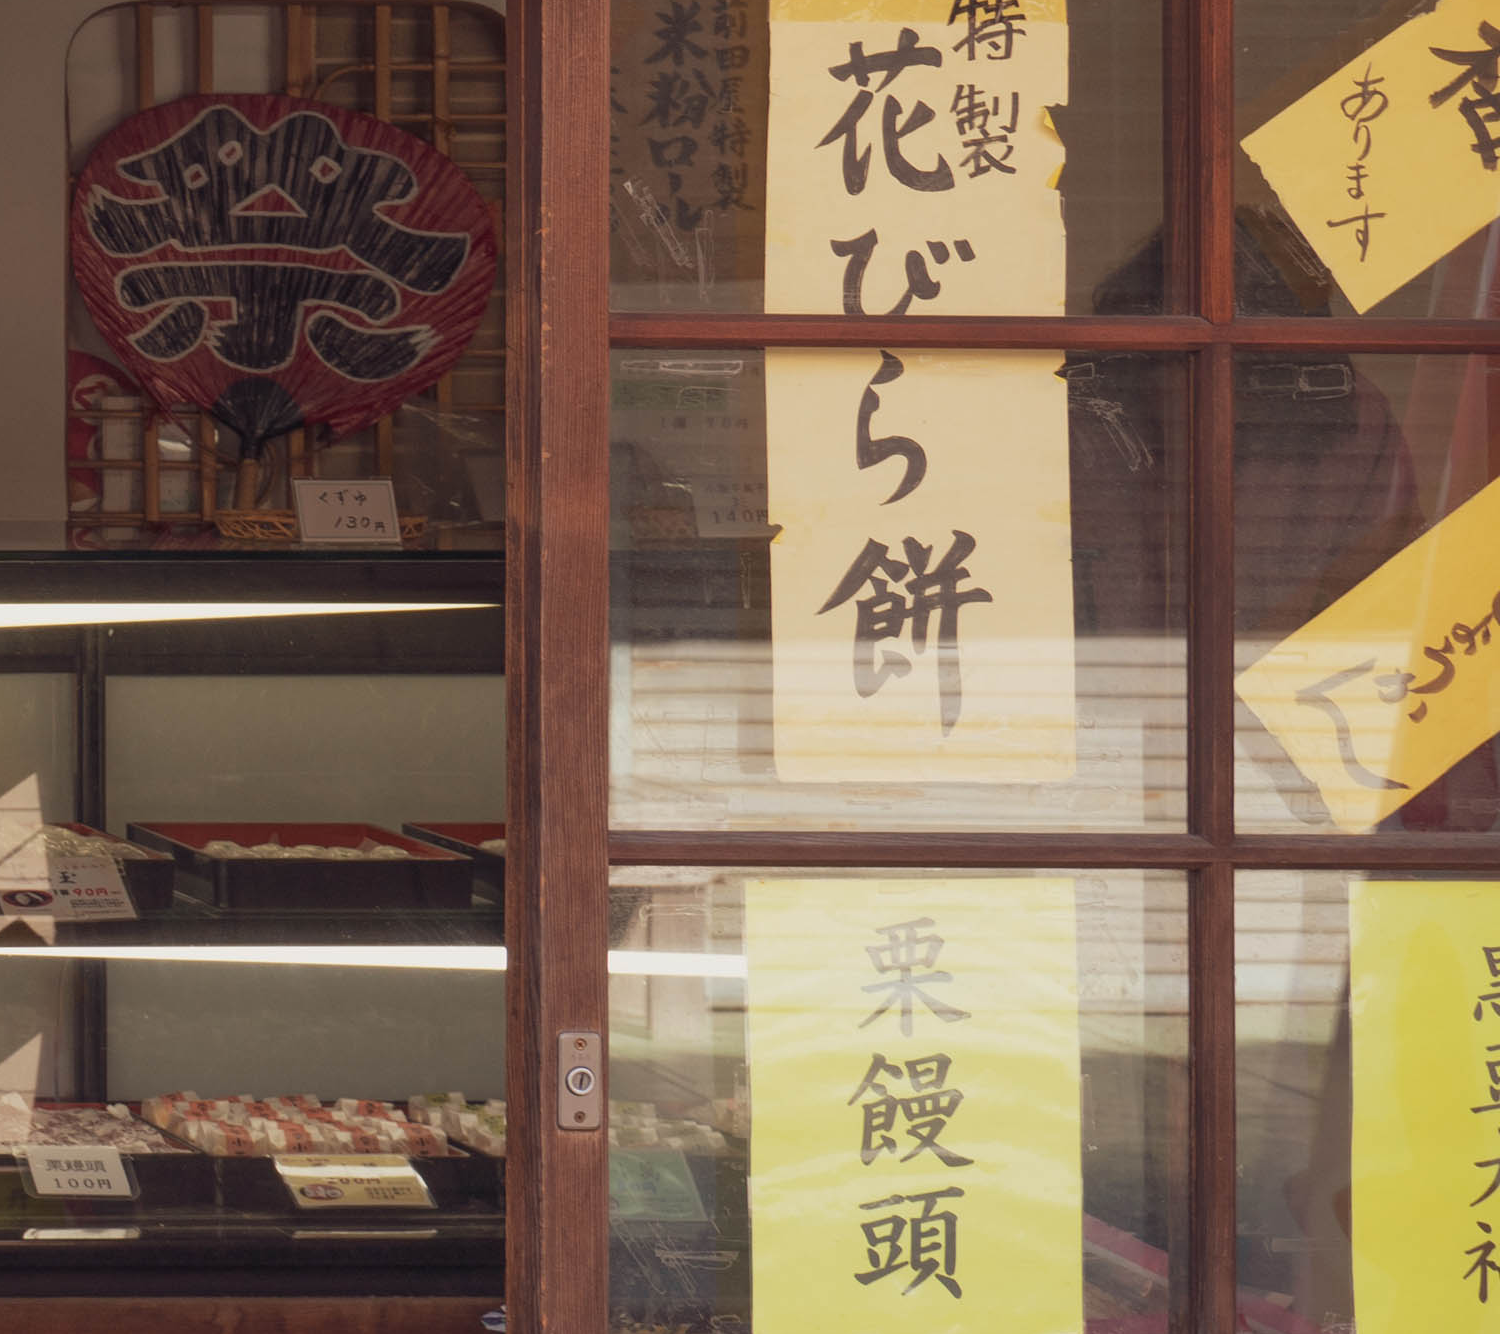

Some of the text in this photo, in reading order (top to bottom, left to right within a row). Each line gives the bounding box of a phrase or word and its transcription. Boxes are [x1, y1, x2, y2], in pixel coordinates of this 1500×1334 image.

[1327, 62, 1388, 262] あります
[334, 516, 387, 533] 130円
[848, 917, 975, 1301] 栗饅頭
[54, 1177, 112, 1189] 100円
